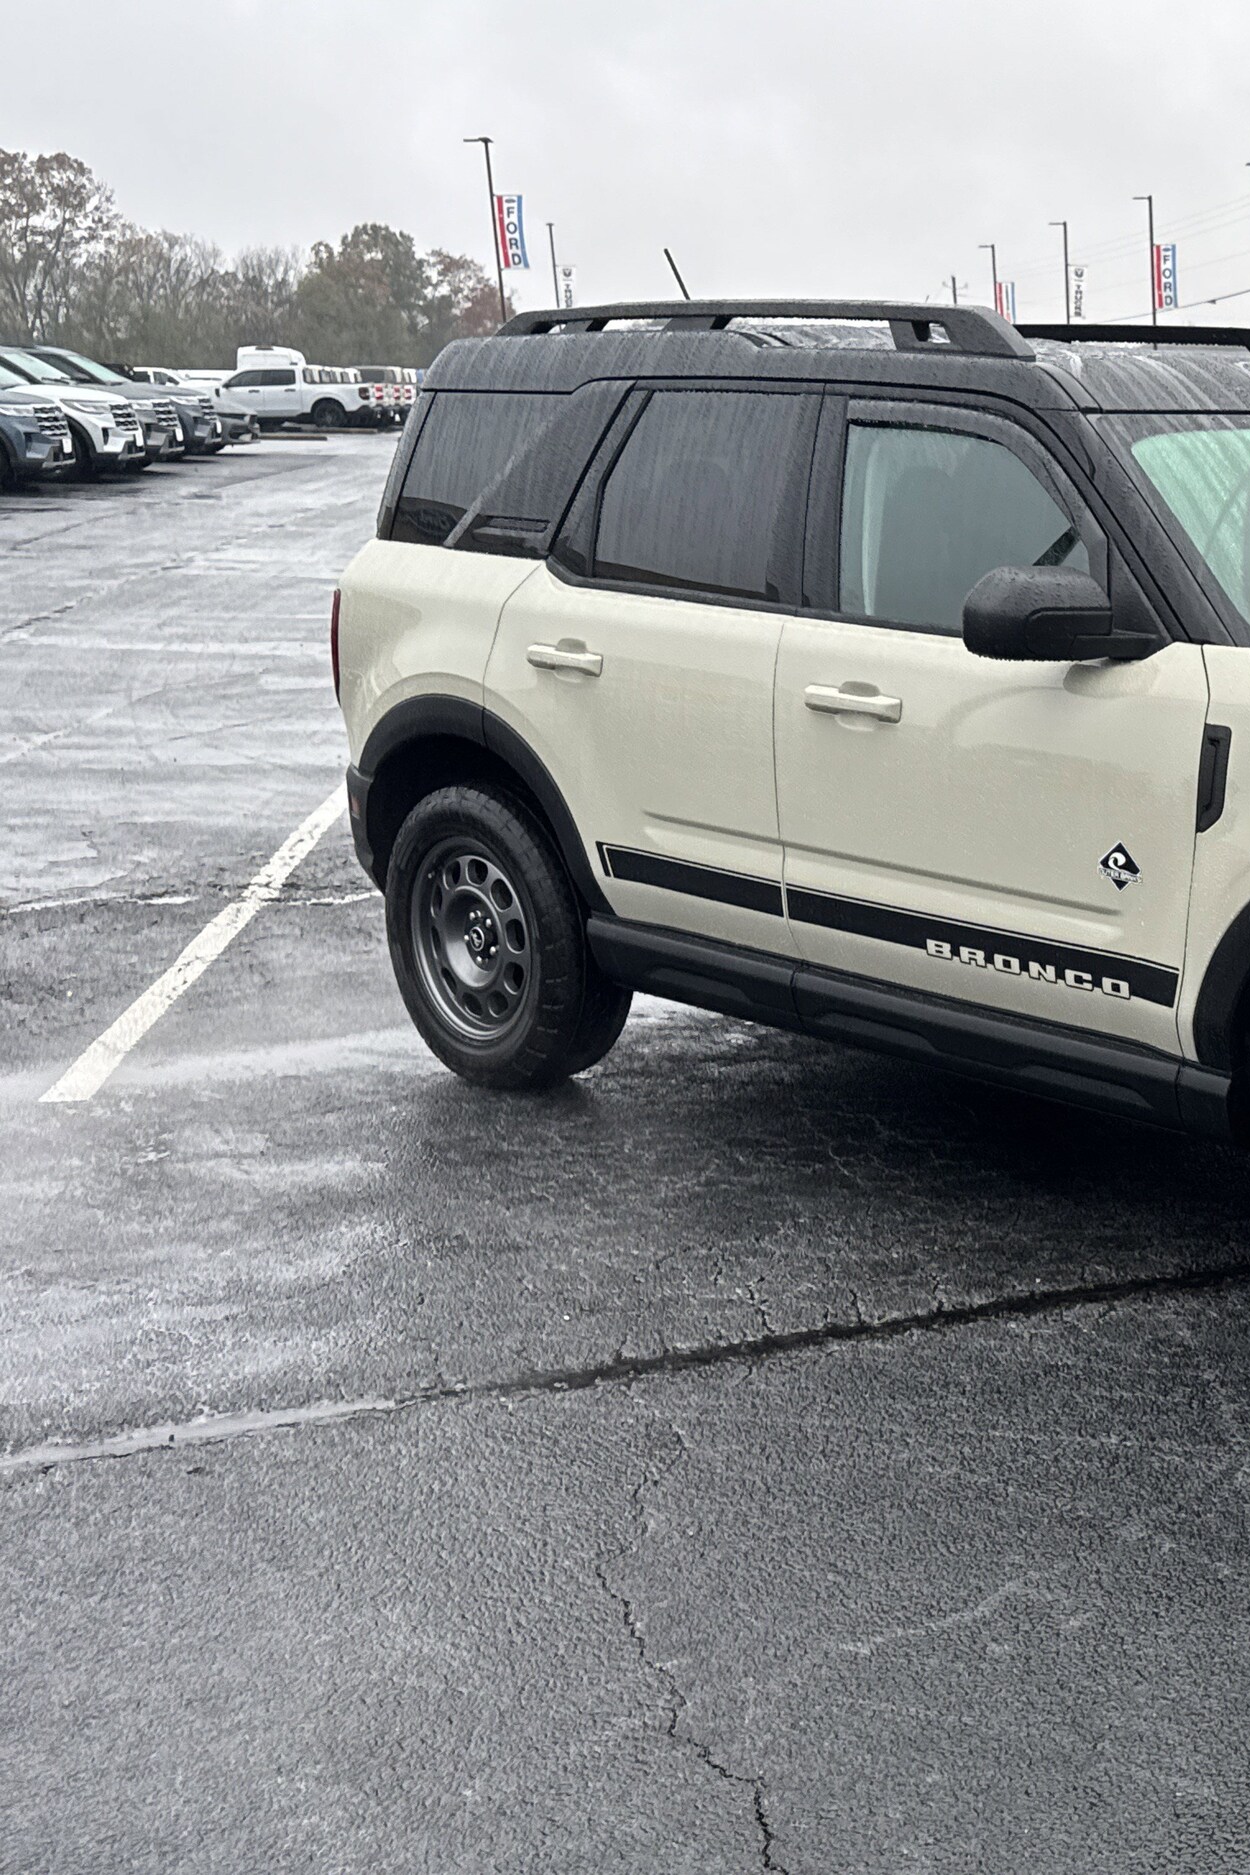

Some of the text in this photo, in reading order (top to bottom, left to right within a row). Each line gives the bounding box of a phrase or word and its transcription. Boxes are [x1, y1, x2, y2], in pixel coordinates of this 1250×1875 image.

[506, 206, 522, 266] FORD
[1162, 254, 1173, 306] FORD
[926, 938, 1131, 1000] BRONCO
